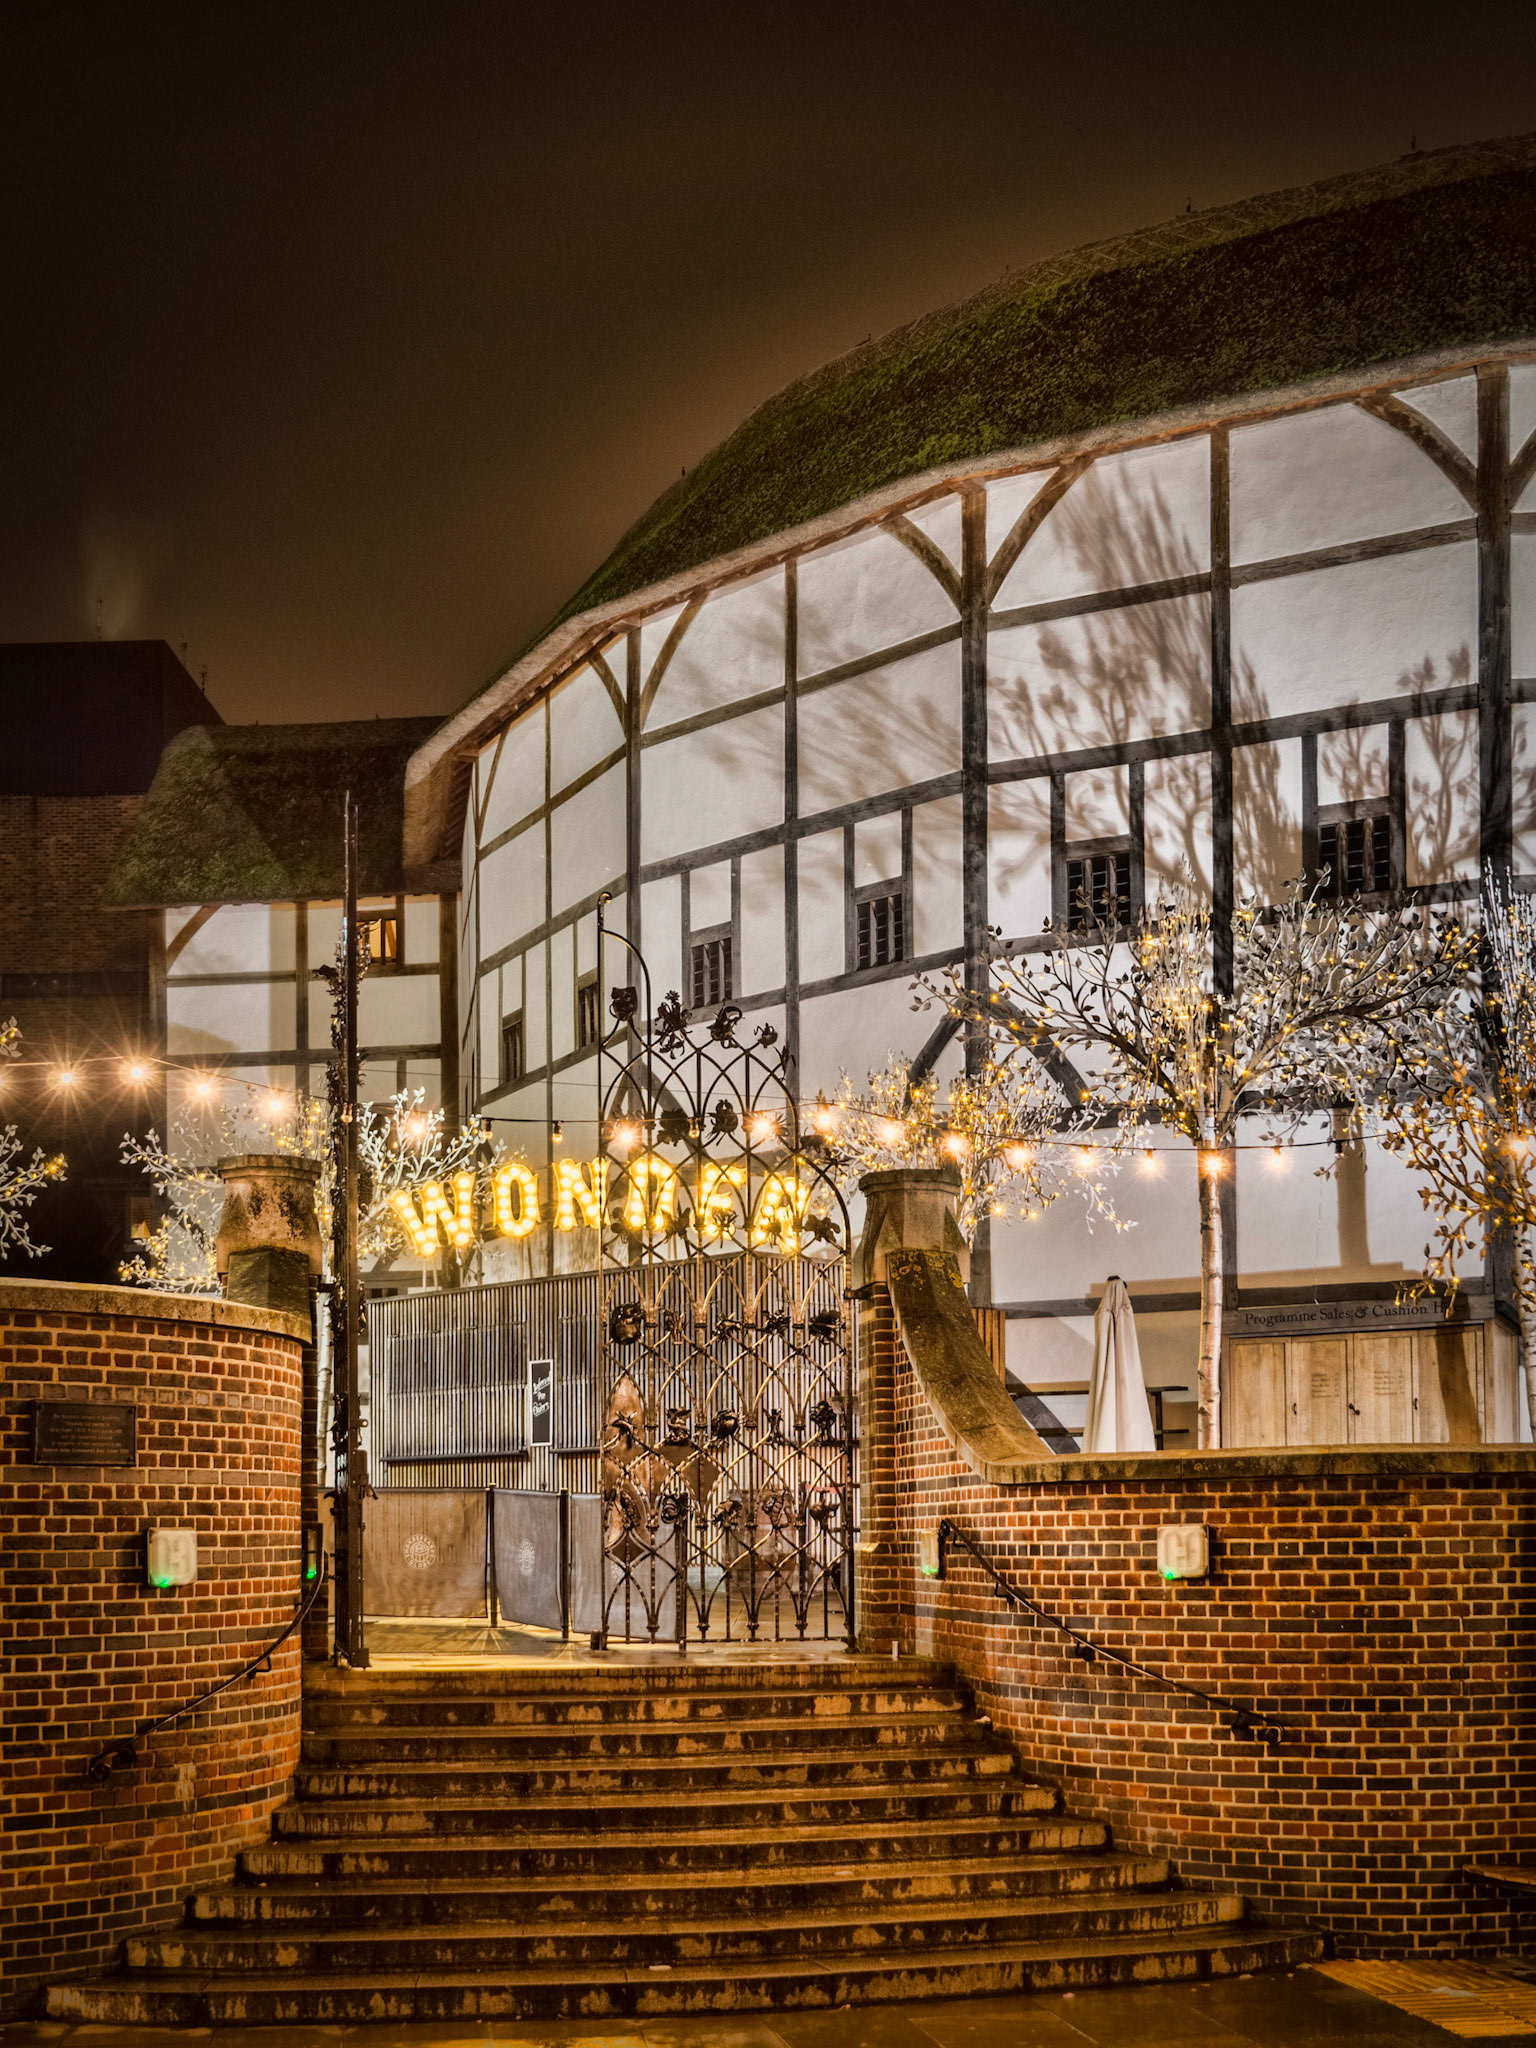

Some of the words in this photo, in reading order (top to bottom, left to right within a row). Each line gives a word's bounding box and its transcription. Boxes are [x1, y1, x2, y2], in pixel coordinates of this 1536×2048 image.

[388, 1157, 811, 1256] WONDER
[1245, 1310, 1317, 1327] Programme
[1320, 1307, 1350, 1321] Sales
[1354, 1305, 1368, 1319] &
[1372, 1302, 1427, 1317] Cushion
